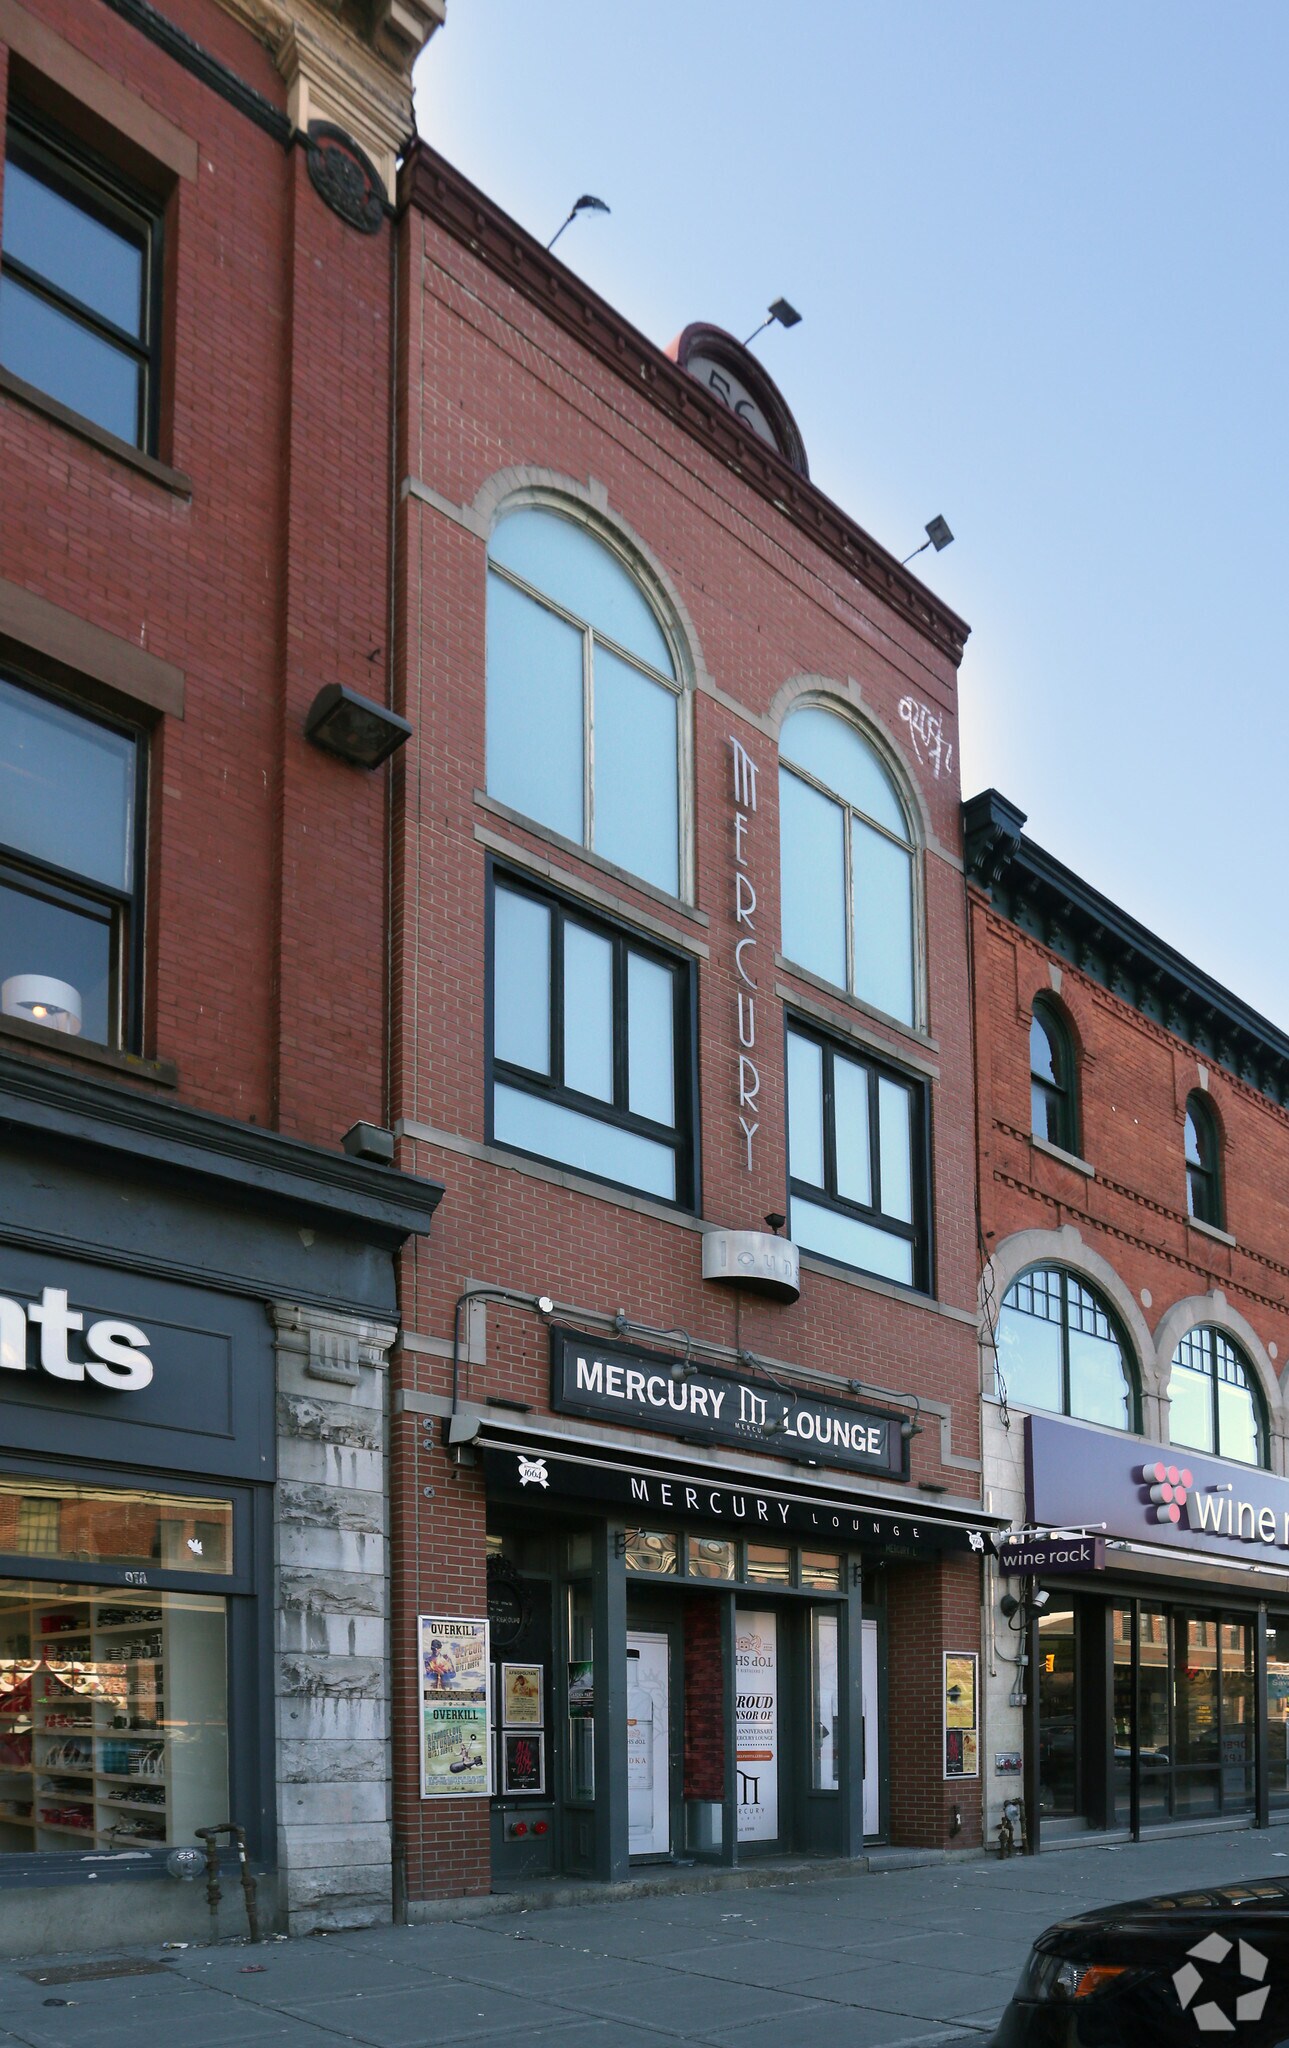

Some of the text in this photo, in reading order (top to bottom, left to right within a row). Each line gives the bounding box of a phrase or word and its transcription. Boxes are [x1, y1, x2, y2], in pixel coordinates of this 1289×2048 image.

[729, 735, 761, 1172] MERCURY
[575, 1357, 882, 1455] MERCURY LOUNGE
[734, 1422, 763, 1434] MERCU
[524, 1468, 542, 1480] 1664
[630, 1477, 920, 1539] MERCURY LOUNGE
[1194, 1483, 1276, 1543] wine
[1003, 1544, 1091, 1567] wine rack
[430, 1623, 477, 1636] OVERKILL
[433, 1709, 479, 1720] OVERKILL
[759, 1710, 773, 1720] OF
